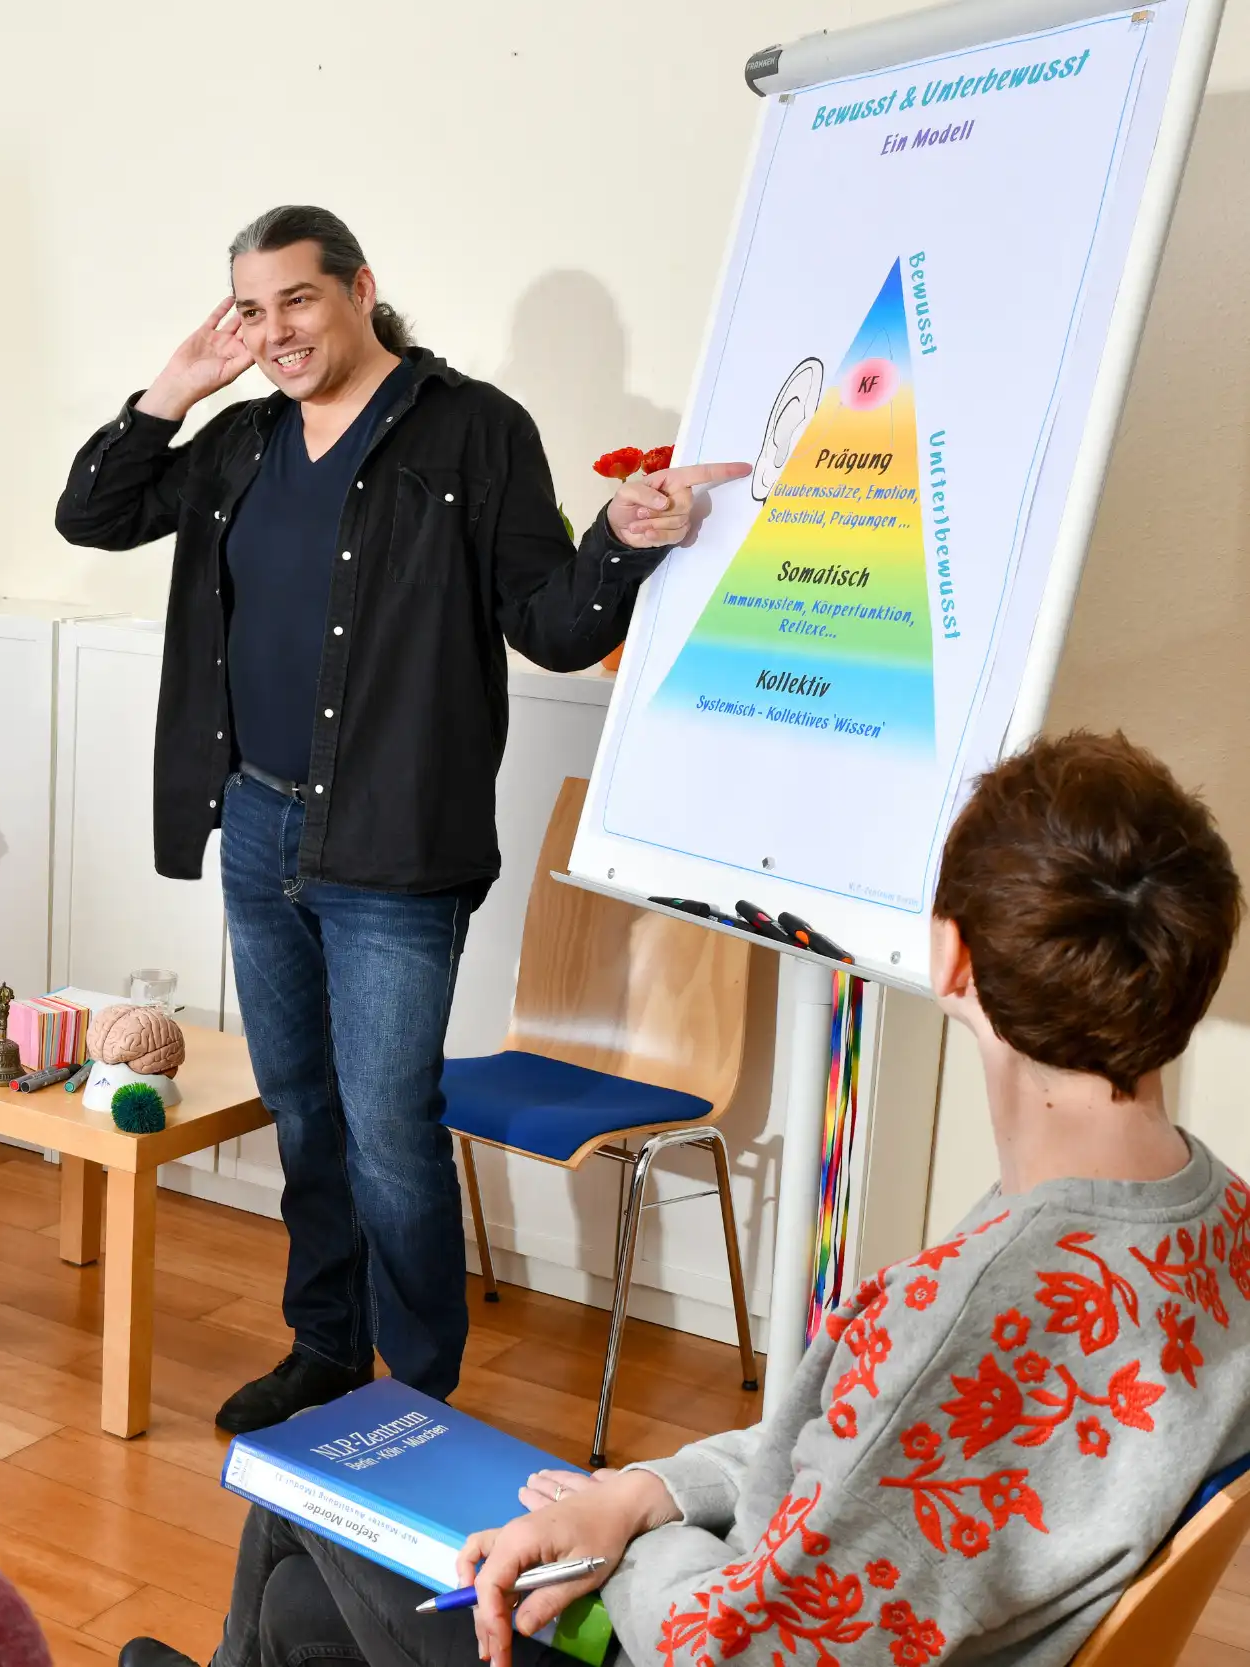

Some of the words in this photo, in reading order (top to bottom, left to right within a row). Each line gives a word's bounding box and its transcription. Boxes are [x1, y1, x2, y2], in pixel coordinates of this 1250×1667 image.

[746, 56, 776, 71] FRANKEN
[811, 89, 898, 131] Bewusst
[899, 85, 917, 111] &
[921, 48, 1091, 108] Unterbewusst
[880, 134, 908, 156] Ein
[911, 119, 976, 150] Modell
[909, 251, 938, 355] Bewusst
[858, 375, 880, 394] KF
[815, 448, 893, 475] Prägung
[773, 483, 862, 502] Glaubenssätze,
[865, 484, 918, 503] Emotion,
[767, 508, 827, 528] Selbstbild,
[829, 511, 897, 531] Prägungen
[929, 430, 961, 640] Un(ter)bewusst
[777, 560, 870, 589] Somatisch
[723, 591, 807, 617] Immunsystem,
[811, 600, 915, 628] Körperfunktion,
[756, 669, 831, 698] Kollektiv
[696, 694, 756, 718] Systemisch
[766, 706, 830, 730] Kollektives
[310, 1411, 428, 1460] NLP-Zentrum
[345, 1456, 380, 1471] Berlin
[376, 1445, 406, 1460] Köln
[402, 1423, 450, 1448] München
[302, 1500, 344, 1529] Mörder
[345, 1518, 380, 1544] Stefan
